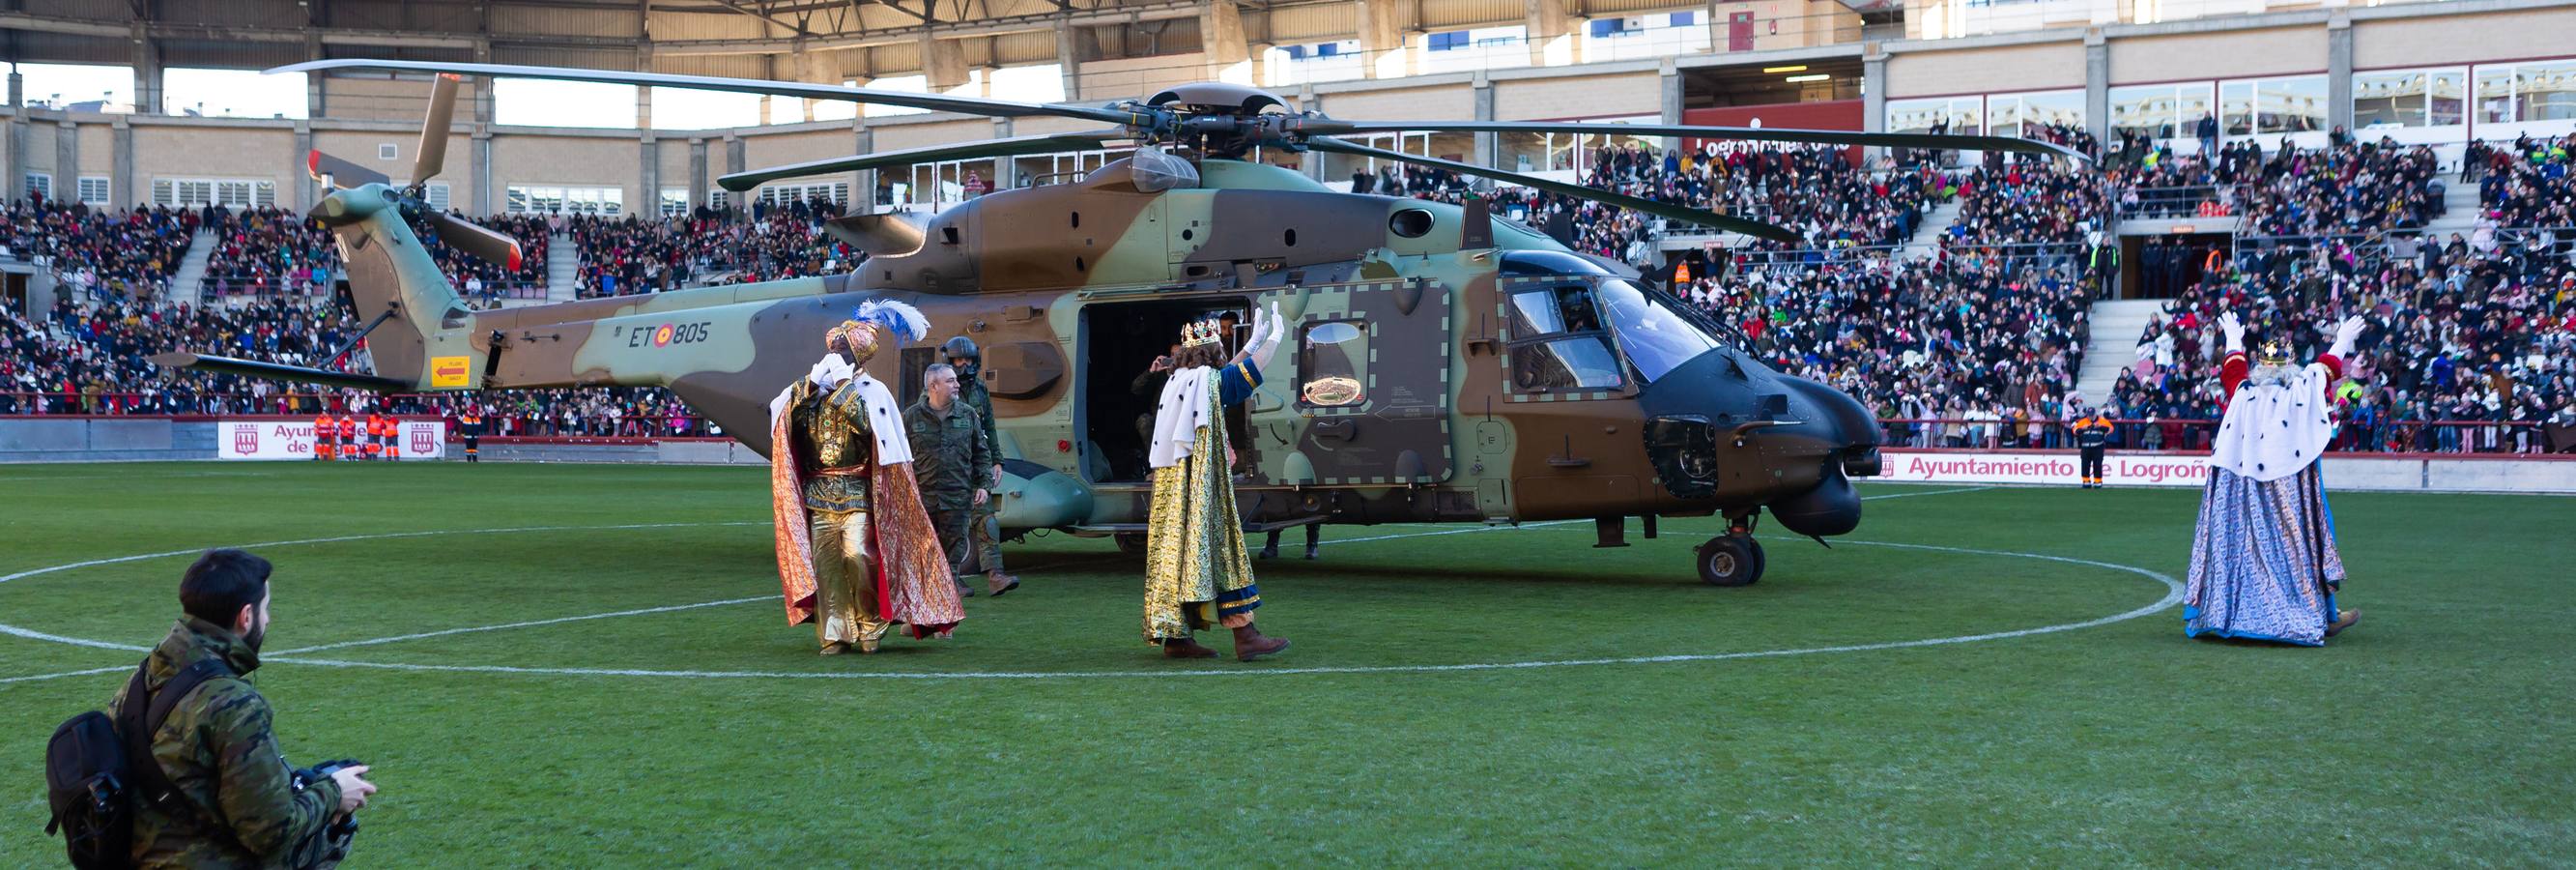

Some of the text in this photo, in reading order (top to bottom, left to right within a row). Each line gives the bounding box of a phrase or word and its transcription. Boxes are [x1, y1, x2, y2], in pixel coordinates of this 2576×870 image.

[629, 326, 656, 348] ET
[673, 322, 712, 344] 805
[287, 440, 308, 453] de
[1908, 457, 2075, 479] Ayuntamiento
